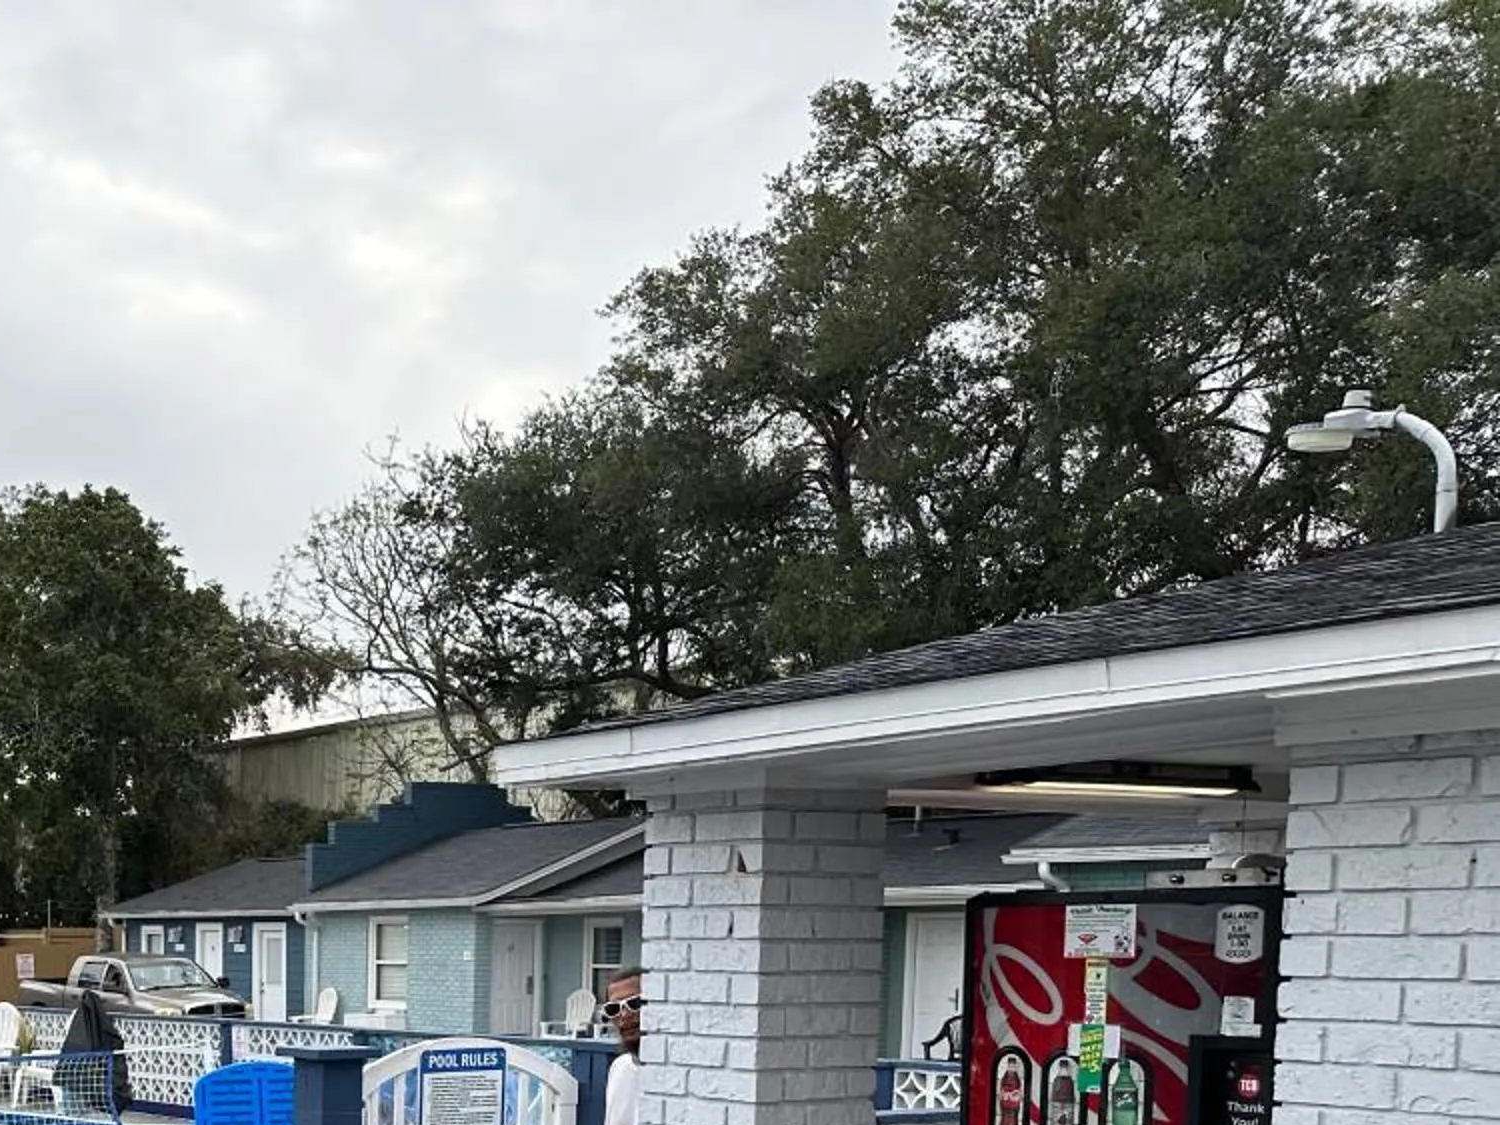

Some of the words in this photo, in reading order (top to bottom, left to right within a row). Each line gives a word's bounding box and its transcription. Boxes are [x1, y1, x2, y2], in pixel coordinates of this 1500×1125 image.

[428, 1054, 459, 1069] POOL
[461, 1052, 498, 1067] RULES
[1227, 1101, 1265, 1114] Thank
